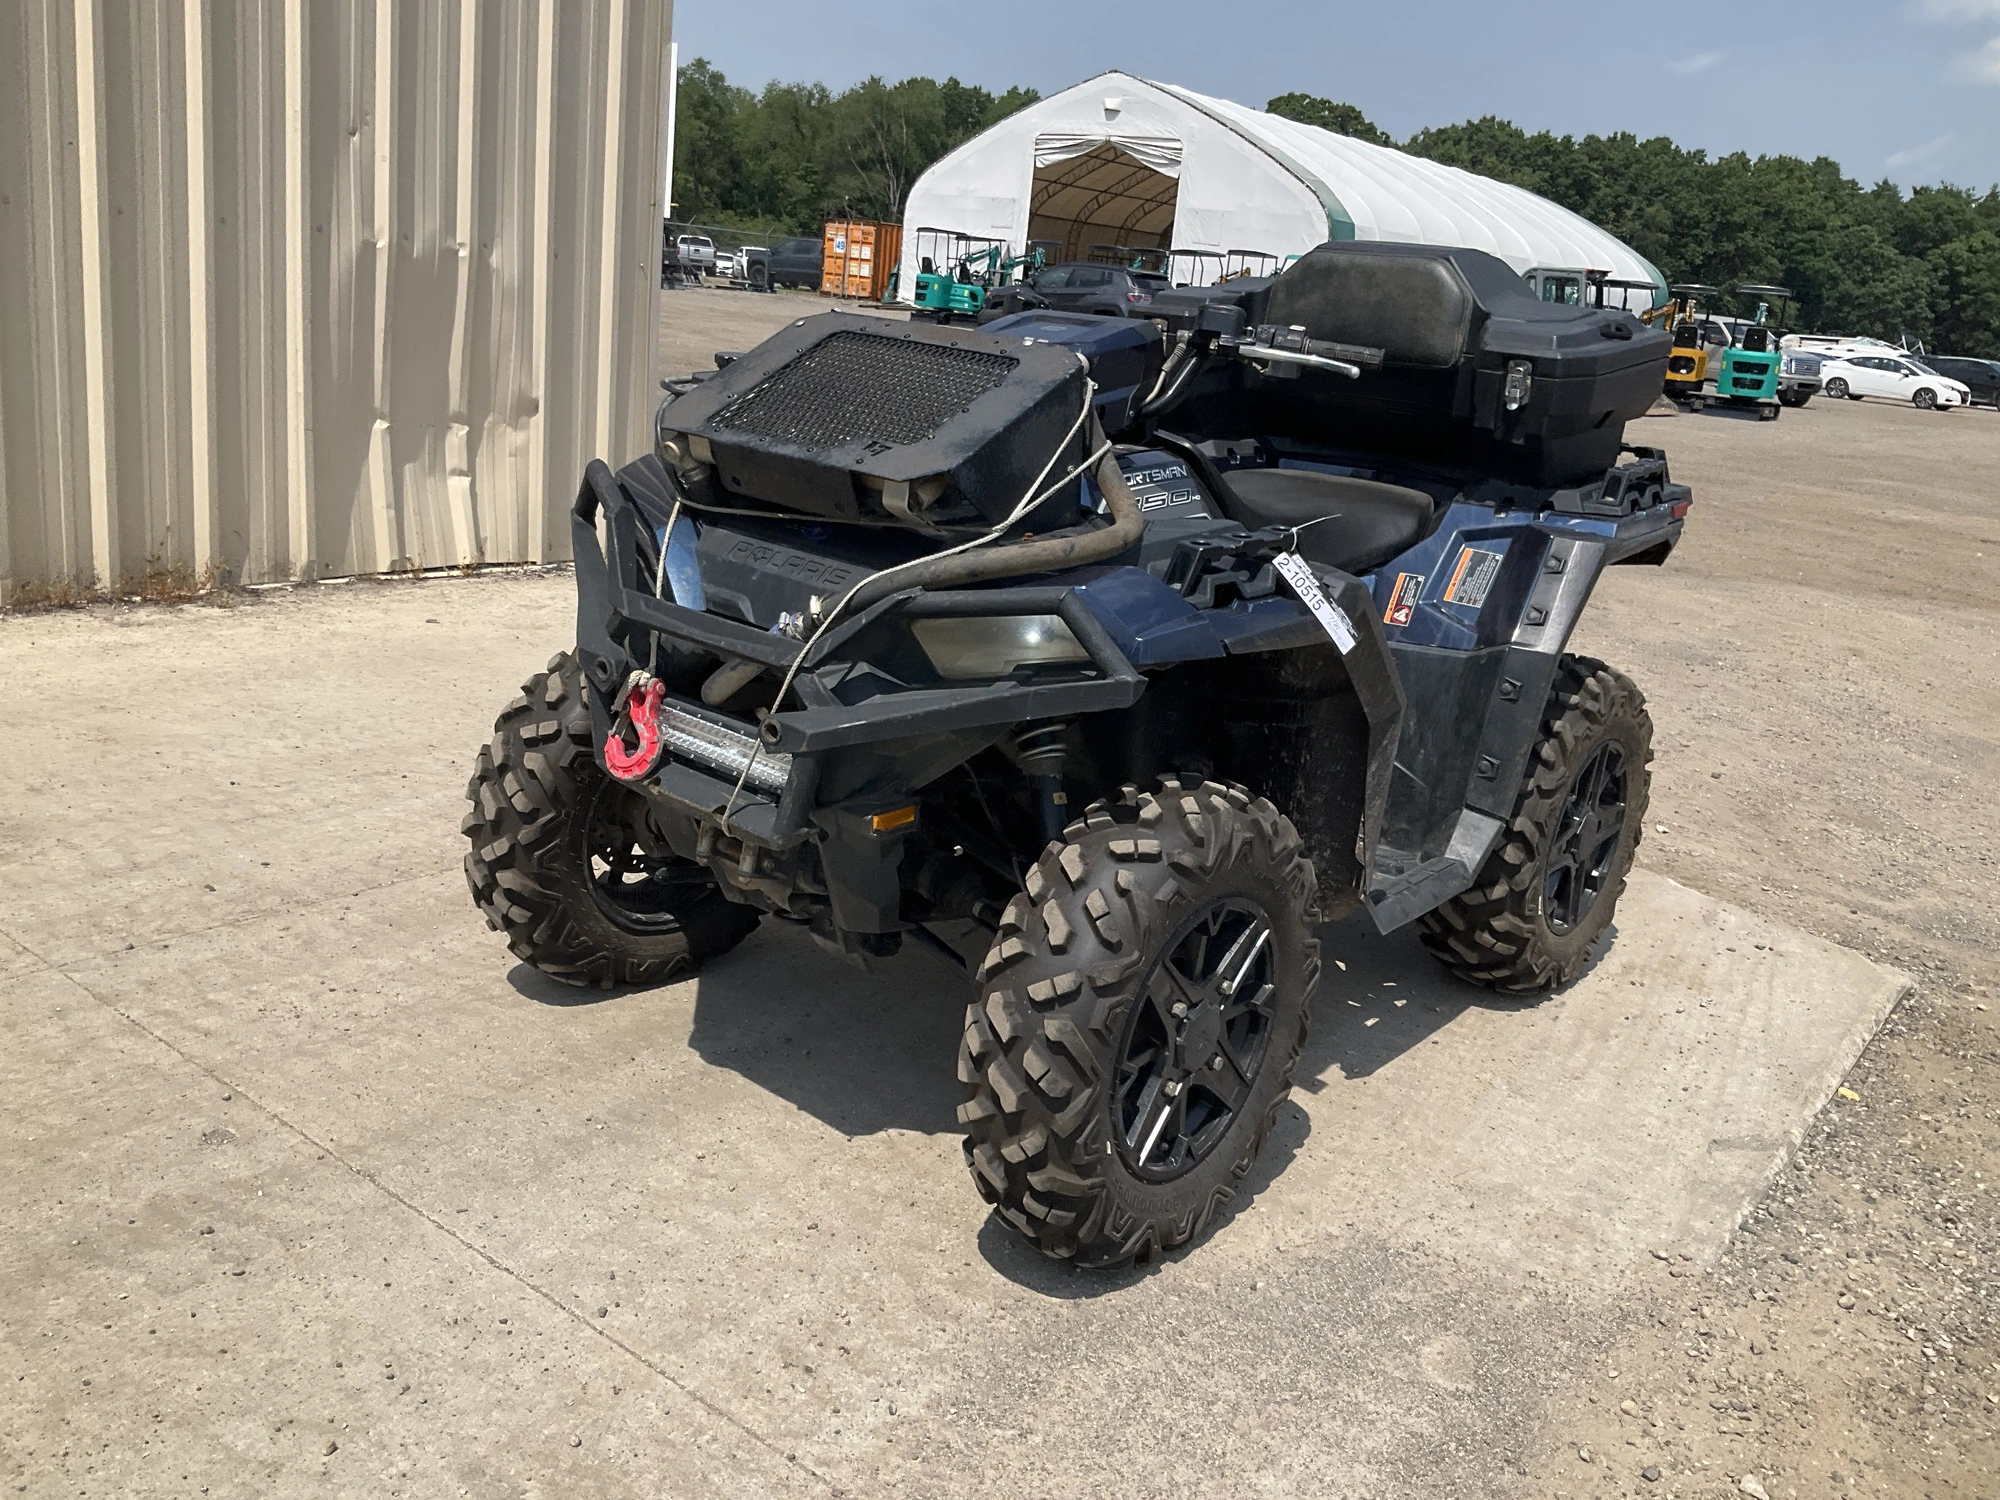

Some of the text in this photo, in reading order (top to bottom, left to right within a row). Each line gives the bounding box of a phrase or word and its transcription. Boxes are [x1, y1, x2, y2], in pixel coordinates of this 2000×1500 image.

[836, 241, 845, 250] 49
[1123, 466, 1187, 485] ORTSMAN
[728, 540, 852, 585] POLARIS
[1277, 557, 1325, 611] 2-10515
